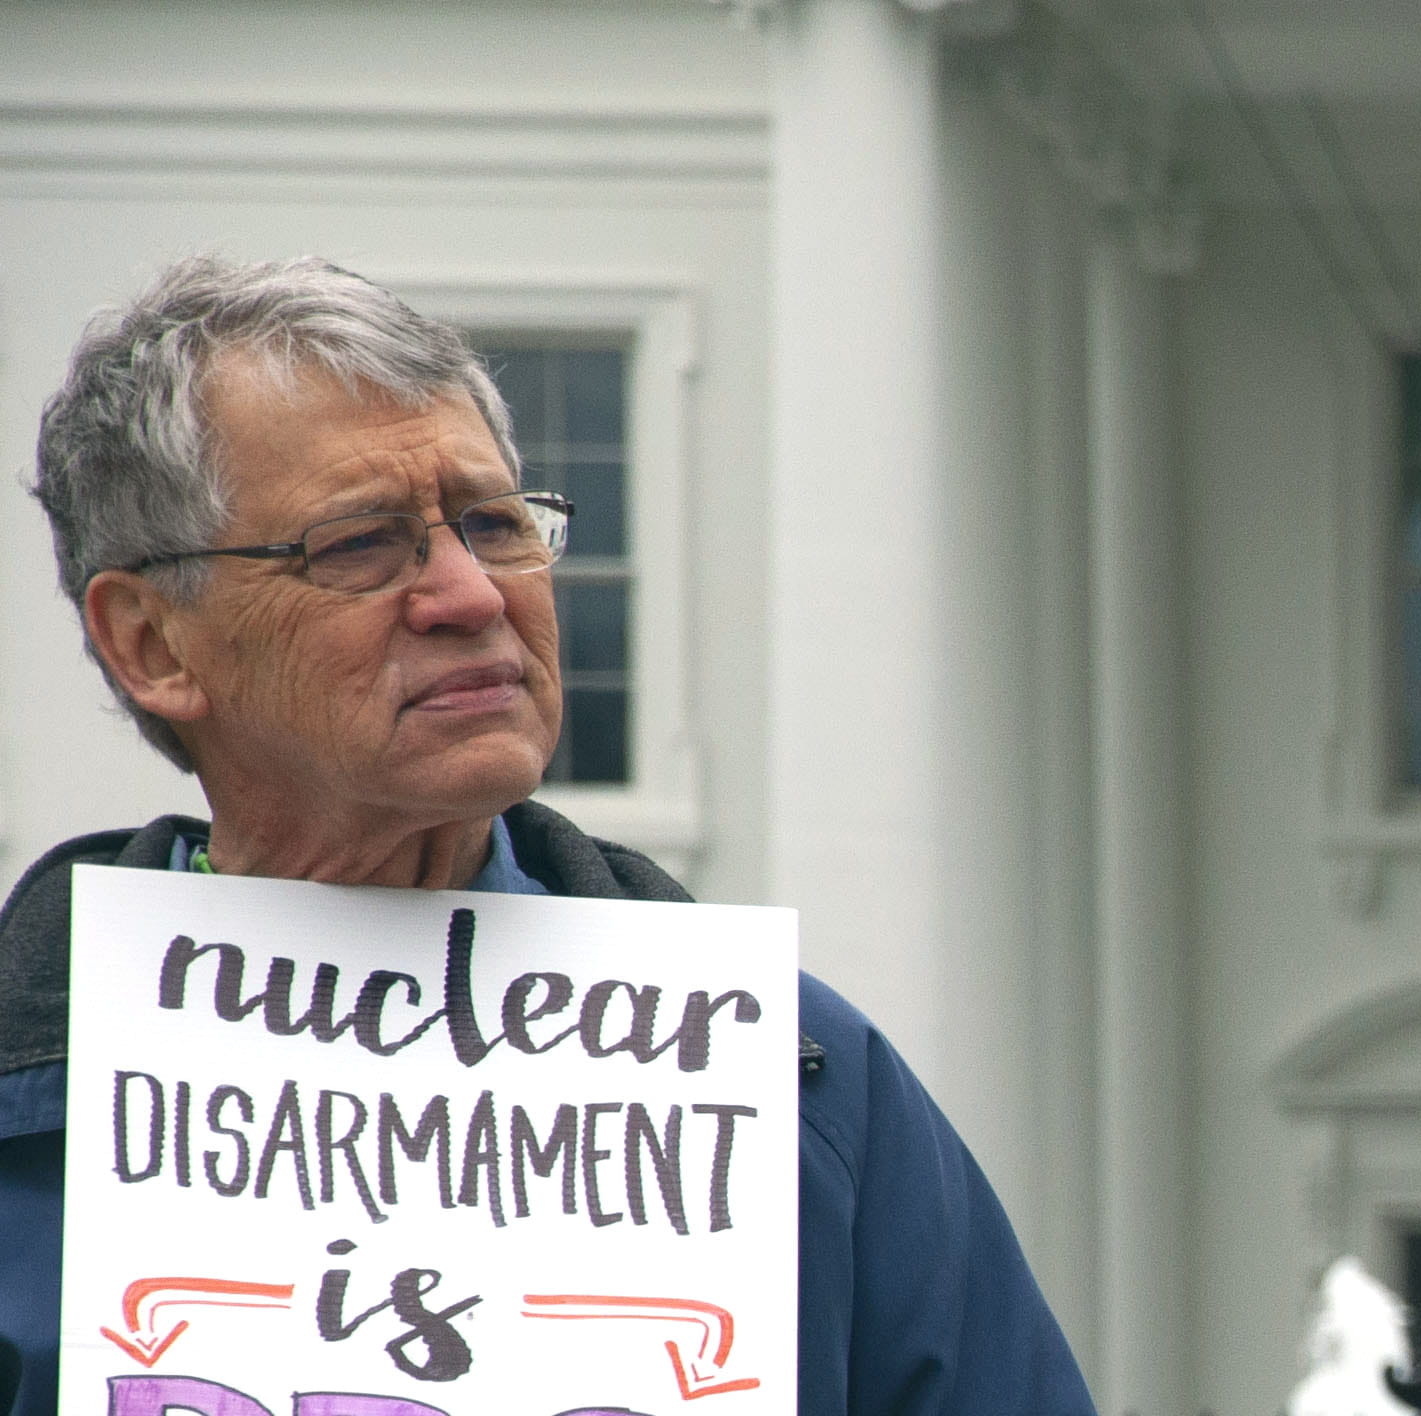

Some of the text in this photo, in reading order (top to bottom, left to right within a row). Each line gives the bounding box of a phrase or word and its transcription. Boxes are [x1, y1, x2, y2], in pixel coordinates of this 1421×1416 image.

[158, 908, 762, 1072] nuclear
[111, 1069, 758, 1236] DISARMAMENT
[316, 1238, 484, 1383] is
